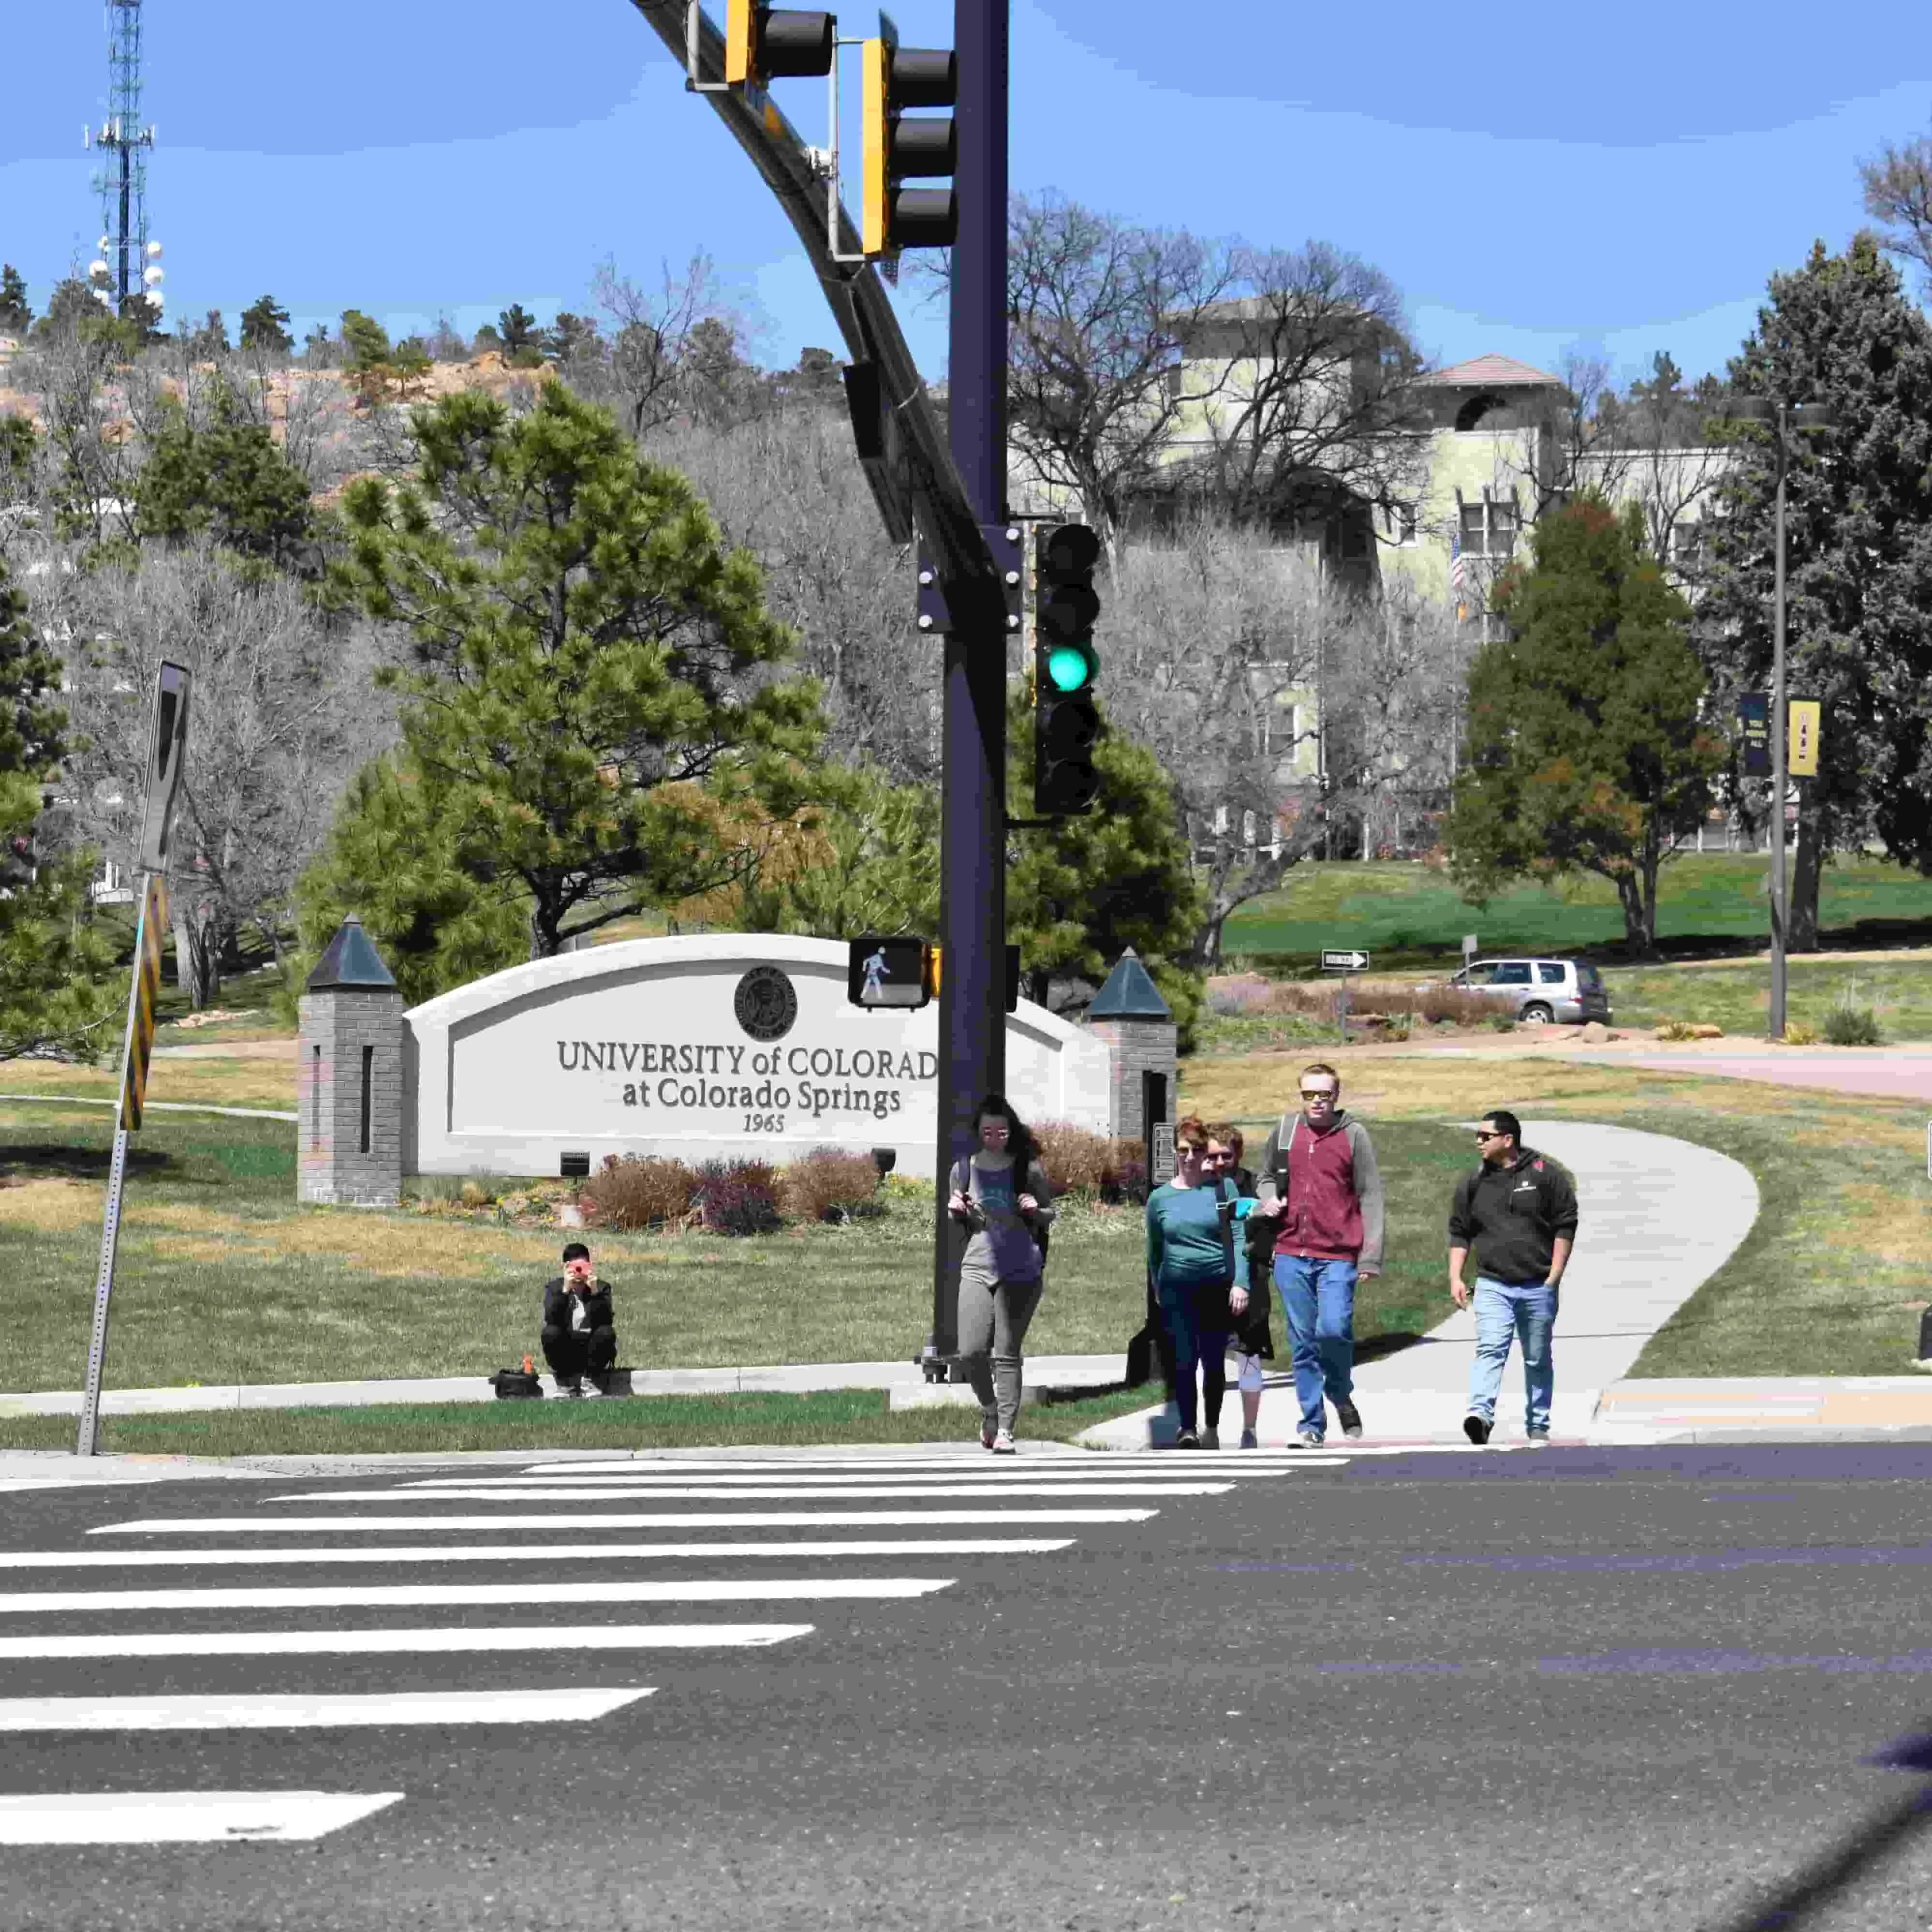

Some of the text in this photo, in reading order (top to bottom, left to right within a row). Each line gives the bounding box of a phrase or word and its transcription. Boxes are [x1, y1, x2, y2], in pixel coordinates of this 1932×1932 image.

[557, 1041, 937, 1080] UNIVERSITY of COLORAD
[622, 1078, 900, 1120] at Colorado Springs
[742, 1113, 785, 1133] 1965
